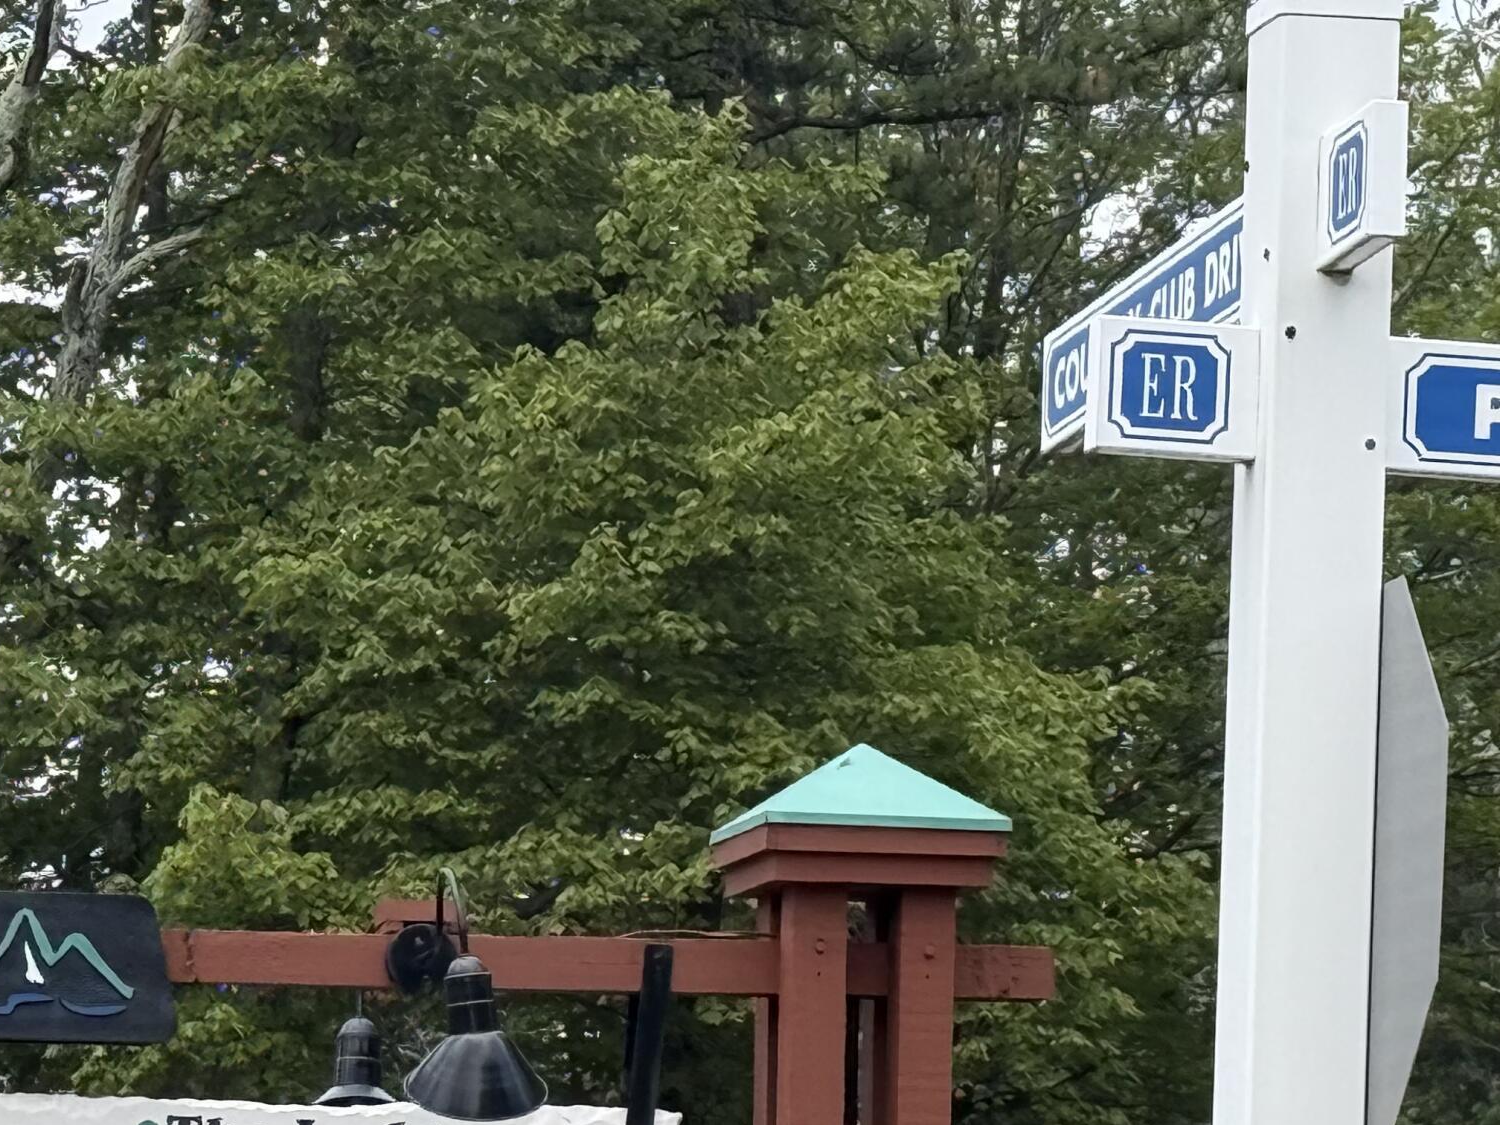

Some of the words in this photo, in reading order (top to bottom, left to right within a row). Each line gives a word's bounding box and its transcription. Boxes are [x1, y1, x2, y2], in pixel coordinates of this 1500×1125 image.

[1337, 147, 1358, 220] ER
[1204, 234, 1240, 308] DRI
[1139, 352, 1199, 421] ER
